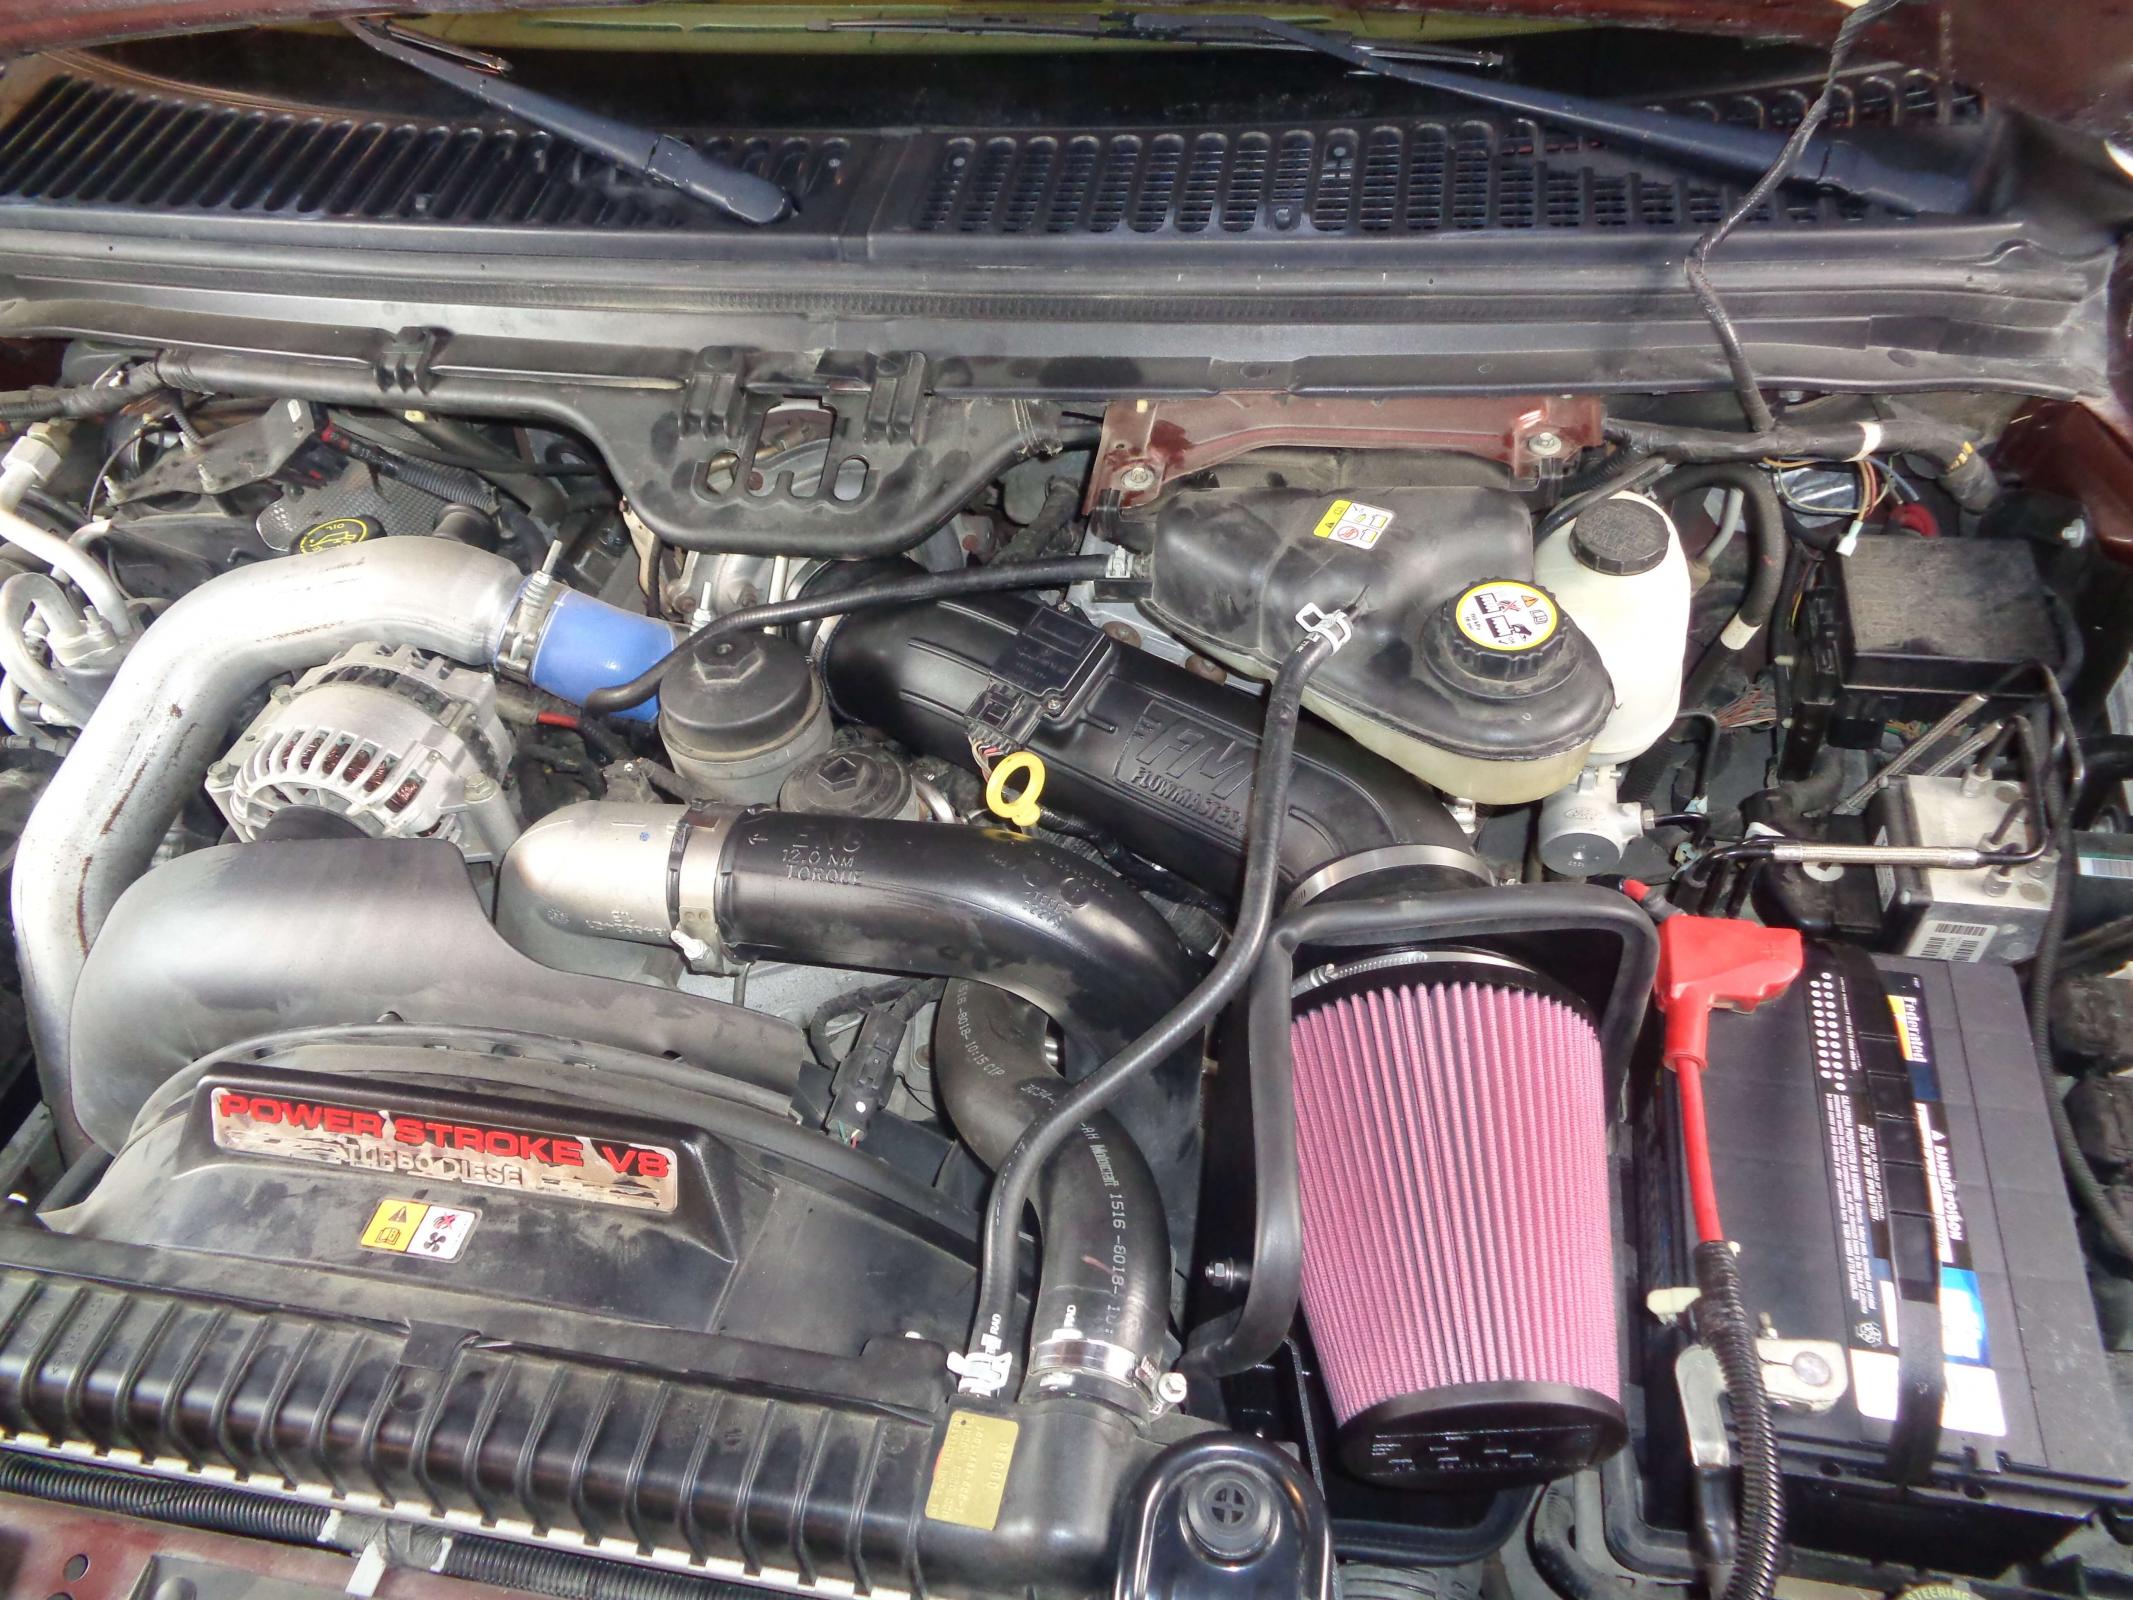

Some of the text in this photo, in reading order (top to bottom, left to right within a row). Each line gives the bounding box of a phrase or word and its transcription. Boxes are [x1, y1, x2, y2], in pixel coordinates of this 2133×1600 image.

[325, 523, 344, 531] OIL
[1132, 764, 1243, 833] FLOWMASTER
[786, 863, 865, 886] TORQUE
[1902, 996, 1928, 1063] Federated
[1839, 1095, 1853, 1126] CALIFORNIA
[219, 1093, 672, 1179] POWER STROKE V8
[343, 1142, 436, 1174] TURBO
[1089, 1144, 1119, 1187] Motorcraft
[1110, 1194, 1125, 1228] 1516
[1112, 1235, 1127, 1295] -8018-
[990, 1313, 1002, 1335] RAD
[1063, 1304, 1077, 1328] RAD
